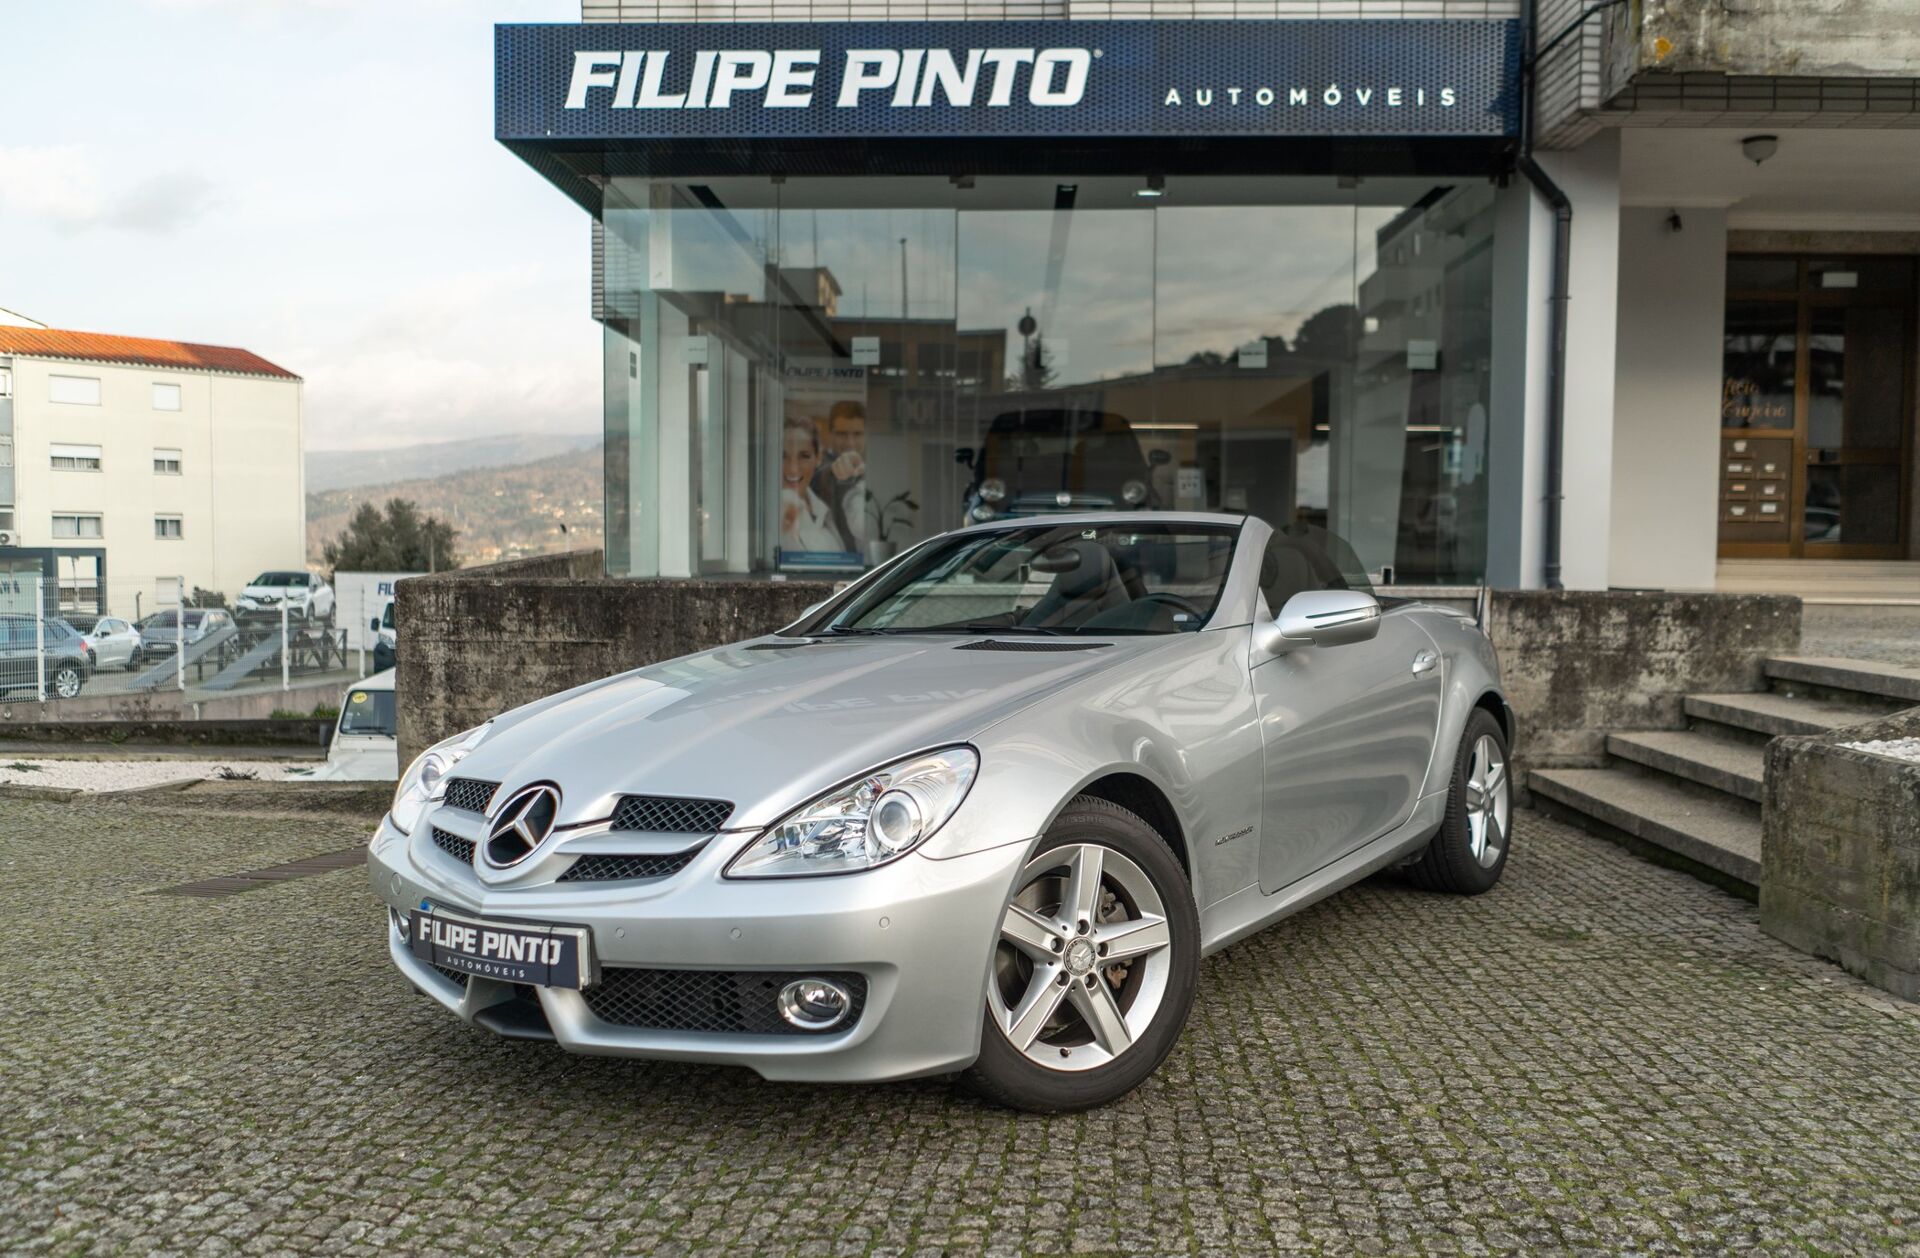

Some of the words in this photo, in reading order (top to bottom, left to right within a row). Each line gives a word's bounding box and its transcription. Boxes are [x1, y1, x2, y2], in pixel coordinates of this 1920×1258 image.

[564, 50, 821, 109] FILIPE
[1165, 84, 1456, 106] AUTOMÓVEIS
[420, 917, 477, 954] FILIPE
